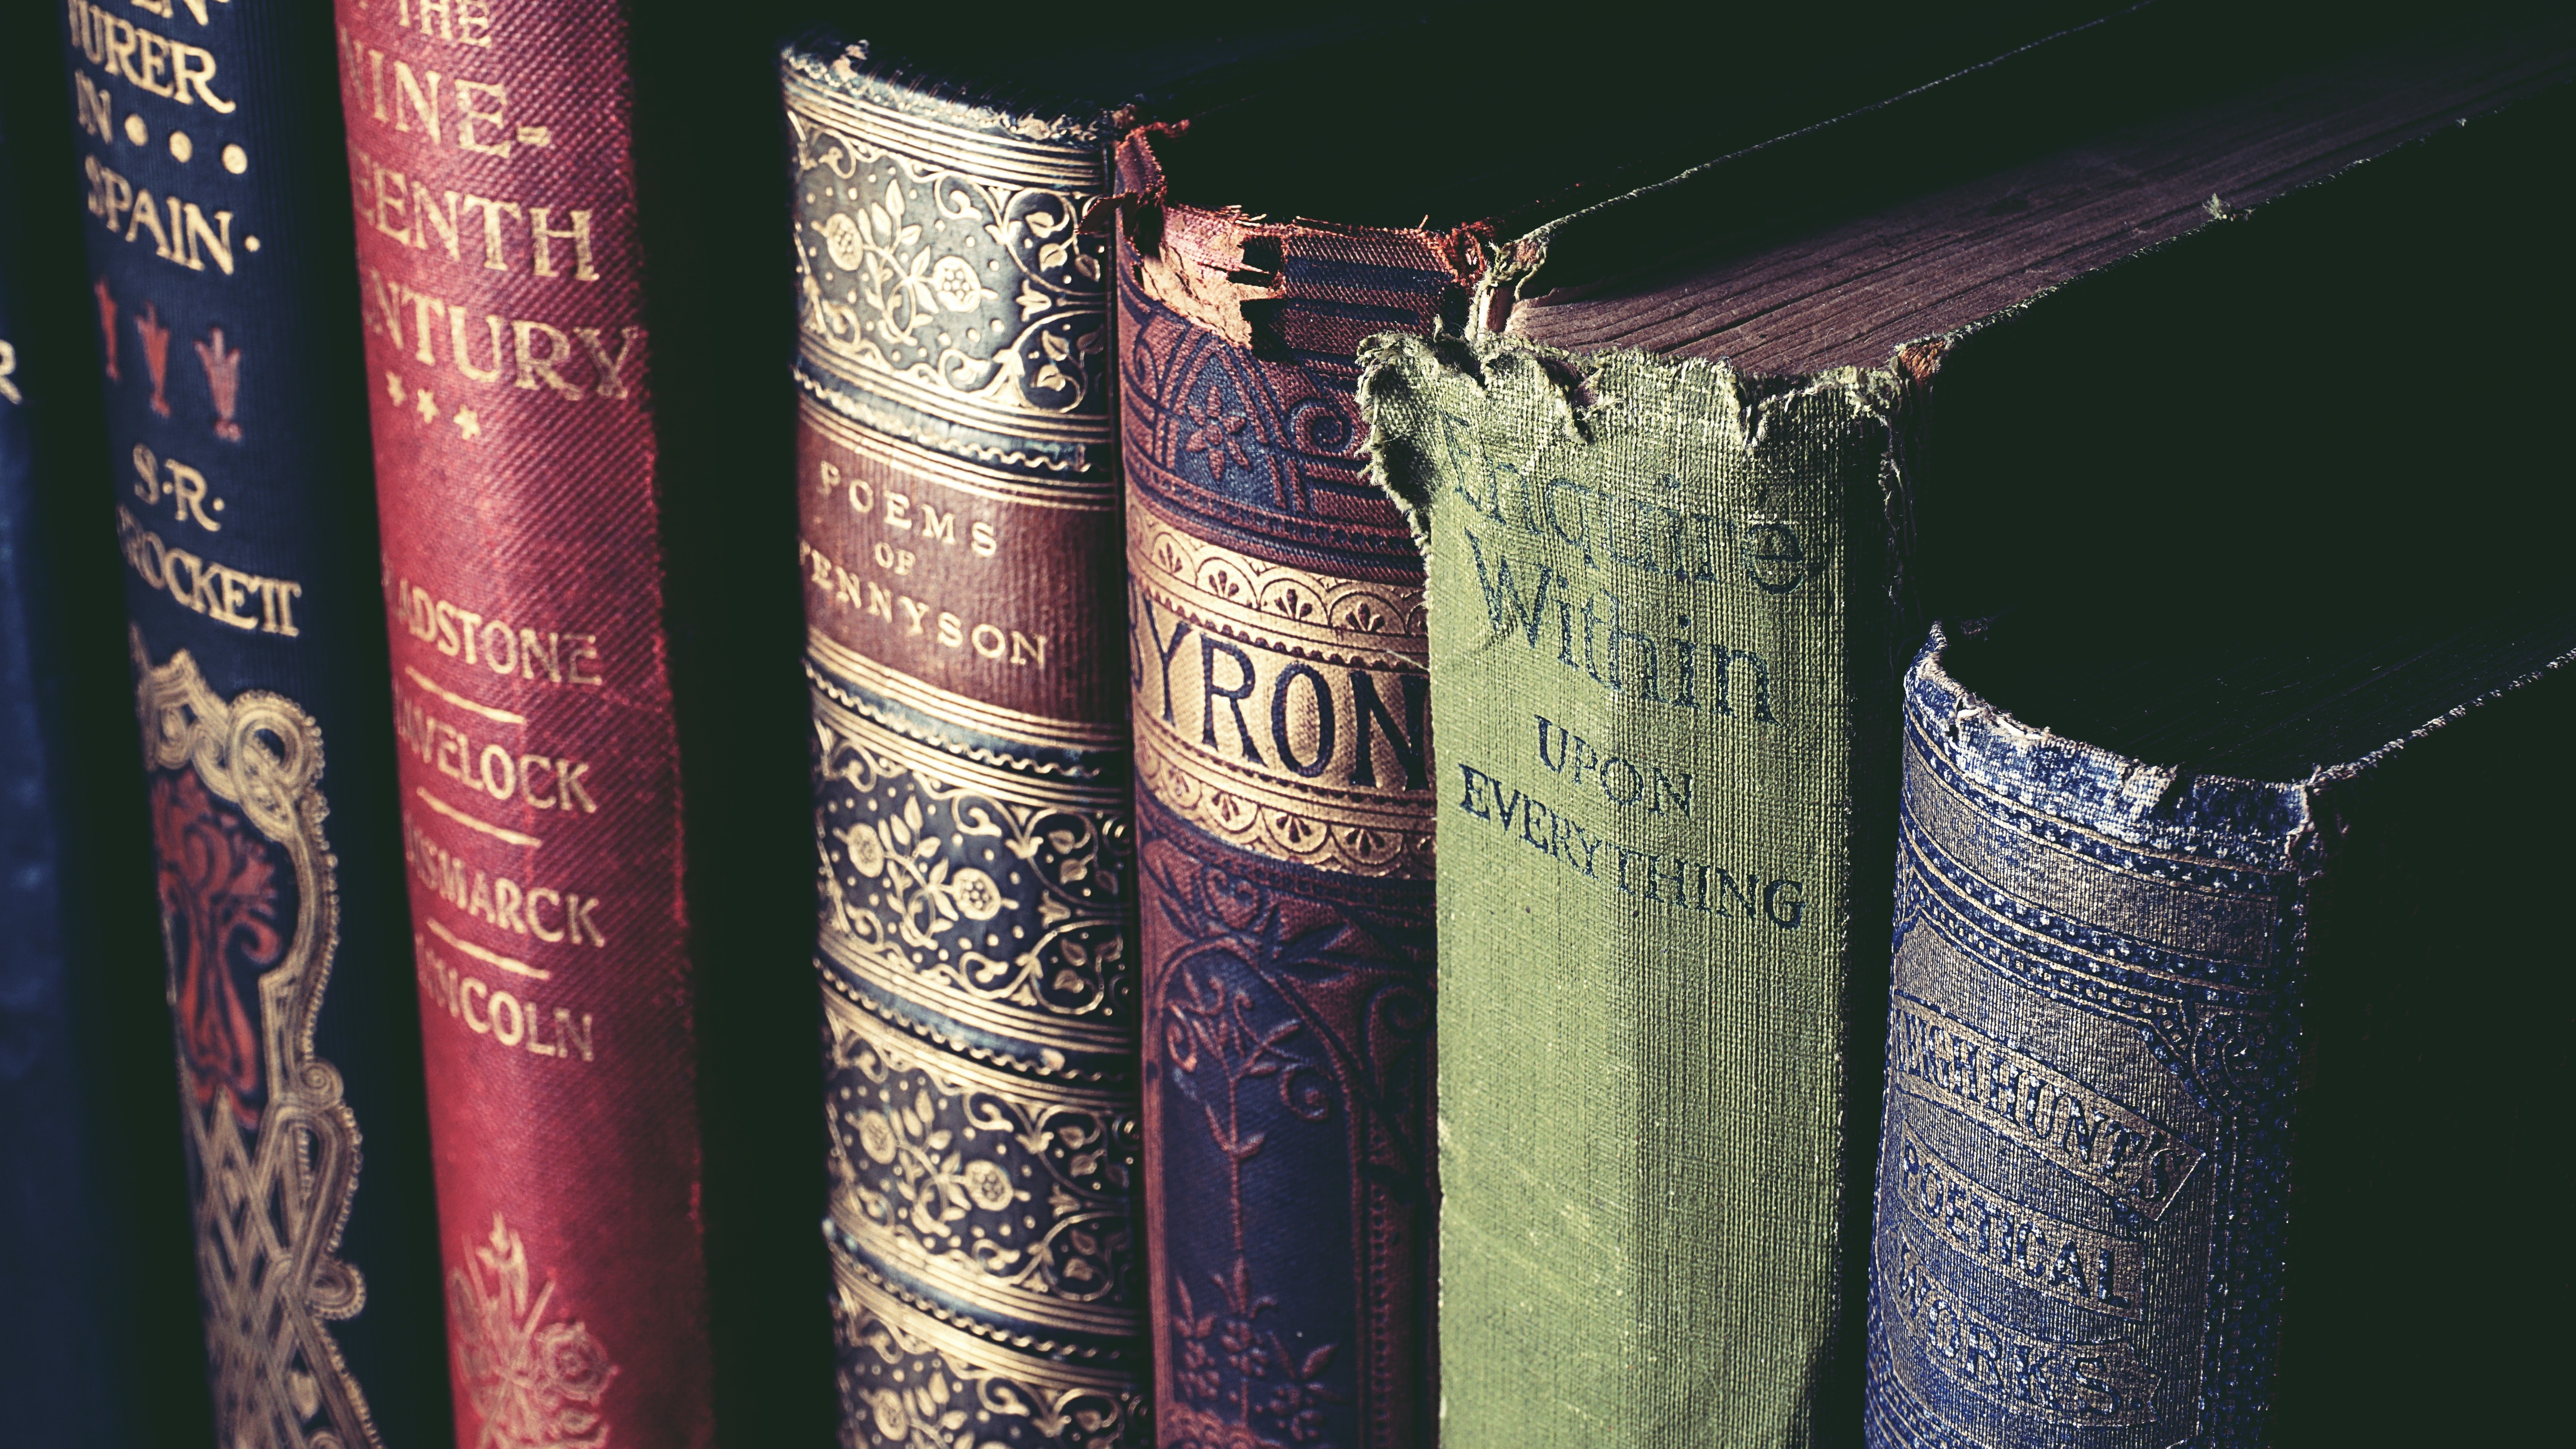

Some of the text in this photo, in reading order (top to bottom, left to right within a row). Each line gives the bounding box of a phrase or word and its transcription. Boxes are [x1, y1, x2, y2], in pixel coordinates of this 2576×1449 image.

[820, 460, 998, 558] POEMS
[874, 542, 916, 576] OF
[1438, 409, 1804, 595] Enquire
[1464, 526, 1783, 729] Within
[1458, 763, 1806, 930] EVERYTHING
[1534, 714, 1693, 820] UPON
[1903, 1142, 2132, 1309] POETICAL
